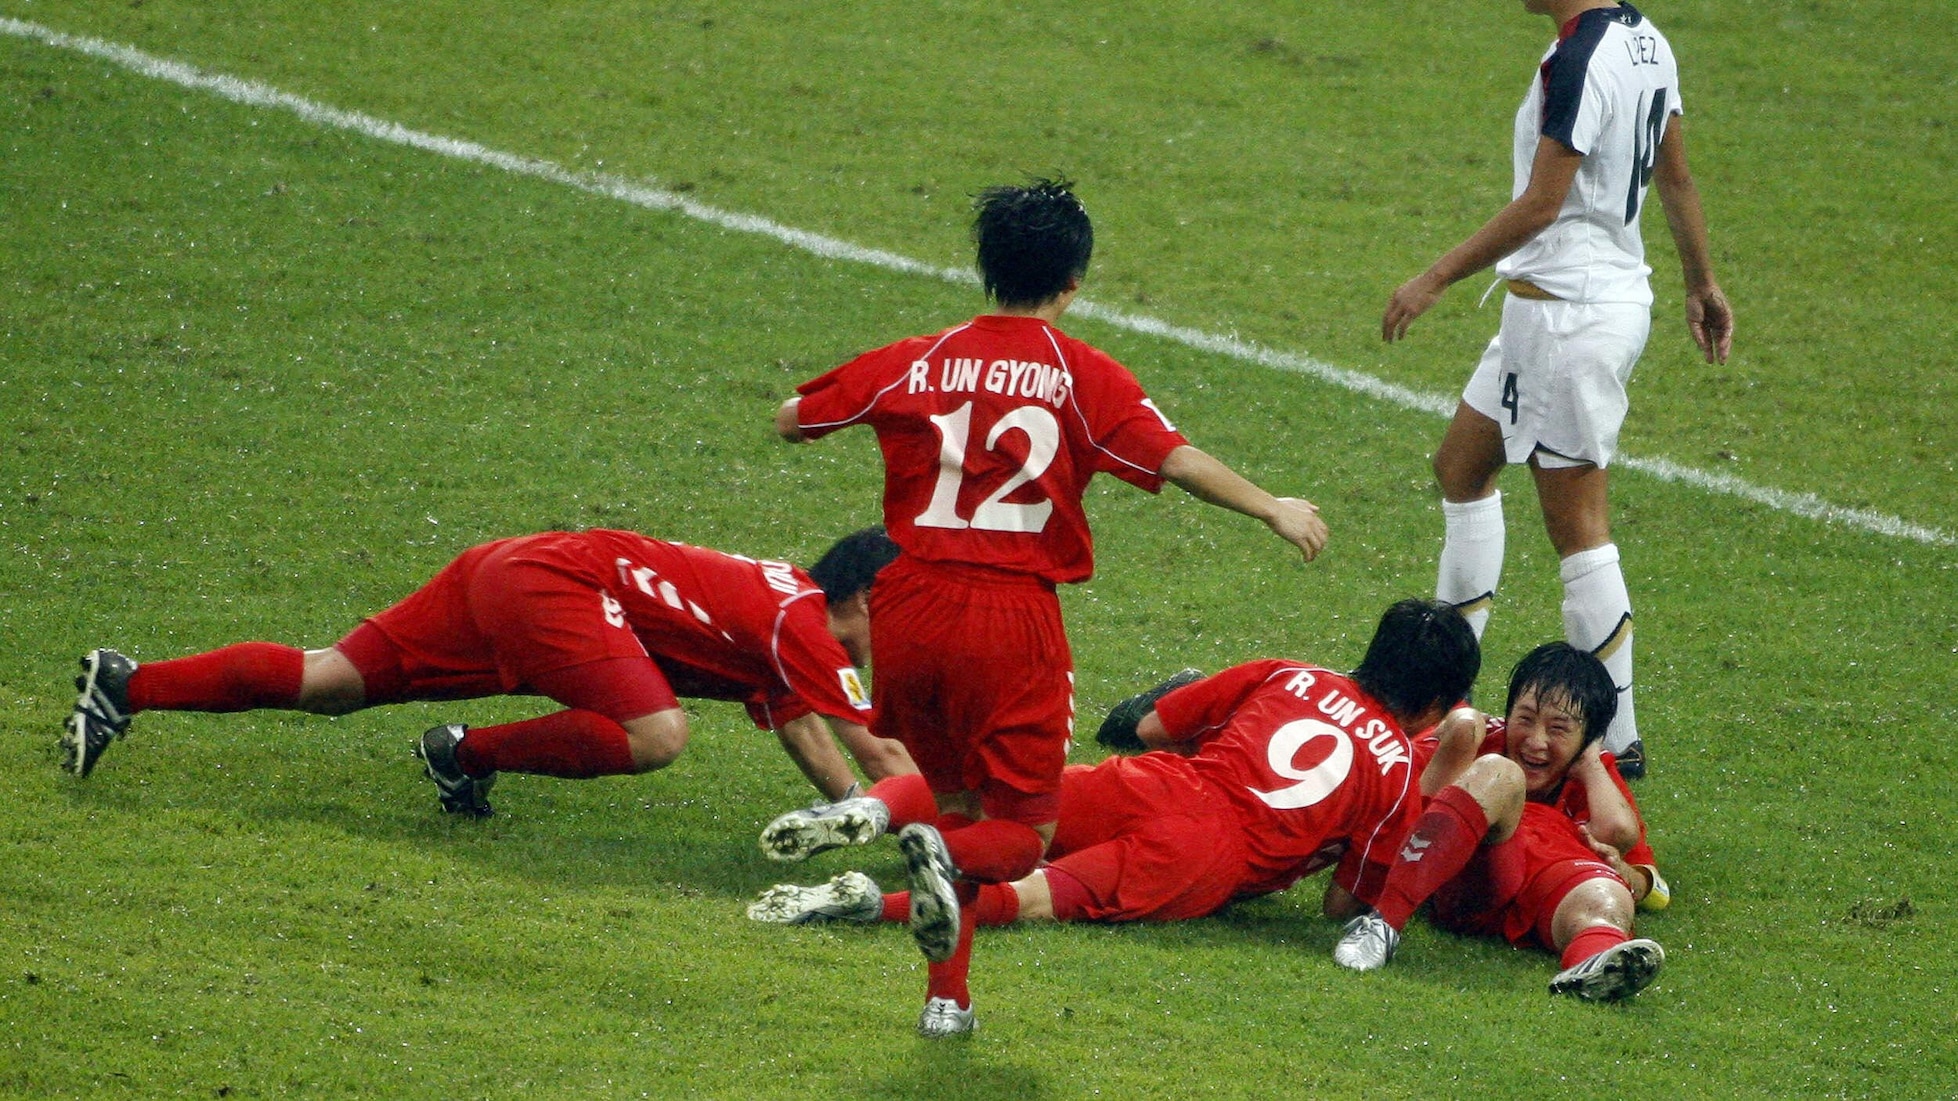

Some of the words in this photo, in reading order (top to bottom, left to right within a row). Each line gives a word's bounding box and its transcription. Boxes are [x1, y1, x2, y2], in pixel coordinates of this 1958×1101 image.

[908, 359, 934, 394] R.
[940, 358, 983, 392] UN
[984, 359, 1072, 409] GYONG
[914, 400, 1060, 533] 12
[1244, 718, 1354, 810] 9
[1284, 670, 1316, 701] R.
[1317, 689, 1366, 727] UN
[1354, 718, 1410, 776] SUK
